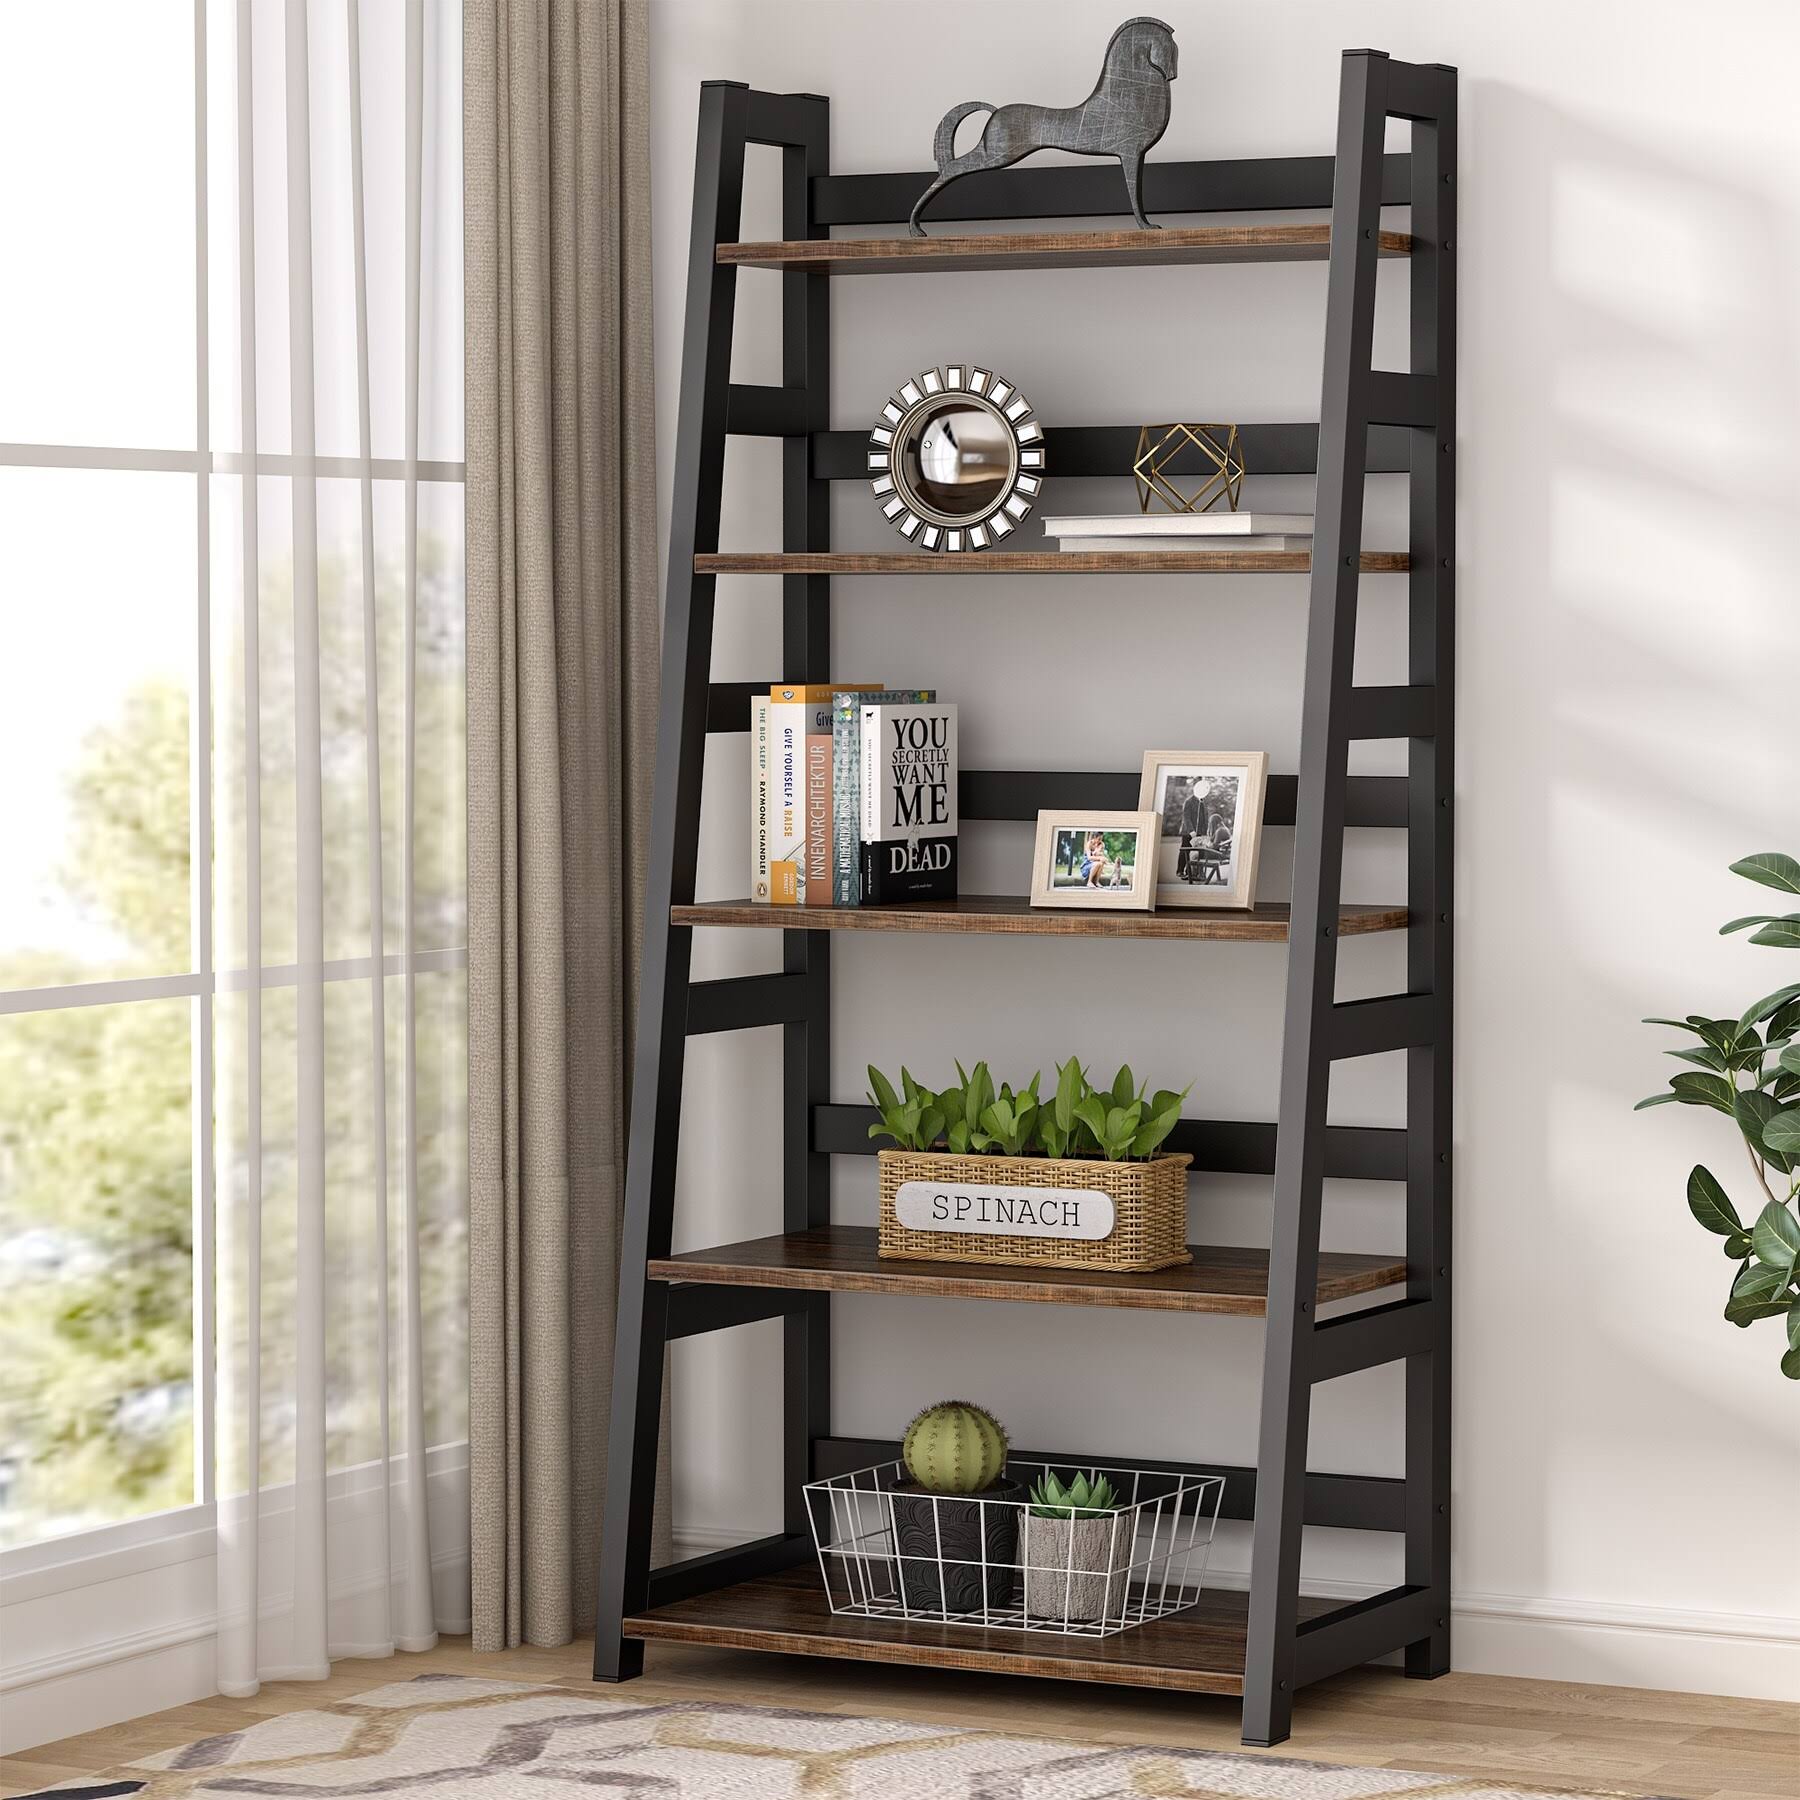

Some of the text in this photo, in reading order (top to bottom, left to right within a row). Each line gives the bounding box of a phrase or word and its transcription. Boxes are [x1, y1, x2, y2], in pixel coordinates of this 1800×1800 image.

[784, 728, 792, 748] GIVE
[891, 717, 949, 750] YOU
[892, 748, 949, 764] SECRETLY
[784, 752, 792, 798] YOURSELF
[891, 763, 949, 785] WANT
[810, 745, 826, 880] INNENARCHITEKTUR
[892, 783, 949, 827] ME
[784, 810, 792, 836] RAISE
[889, 844, 951, 874] DEAD
[932, 1194, 1081, 1227] SPINACH
